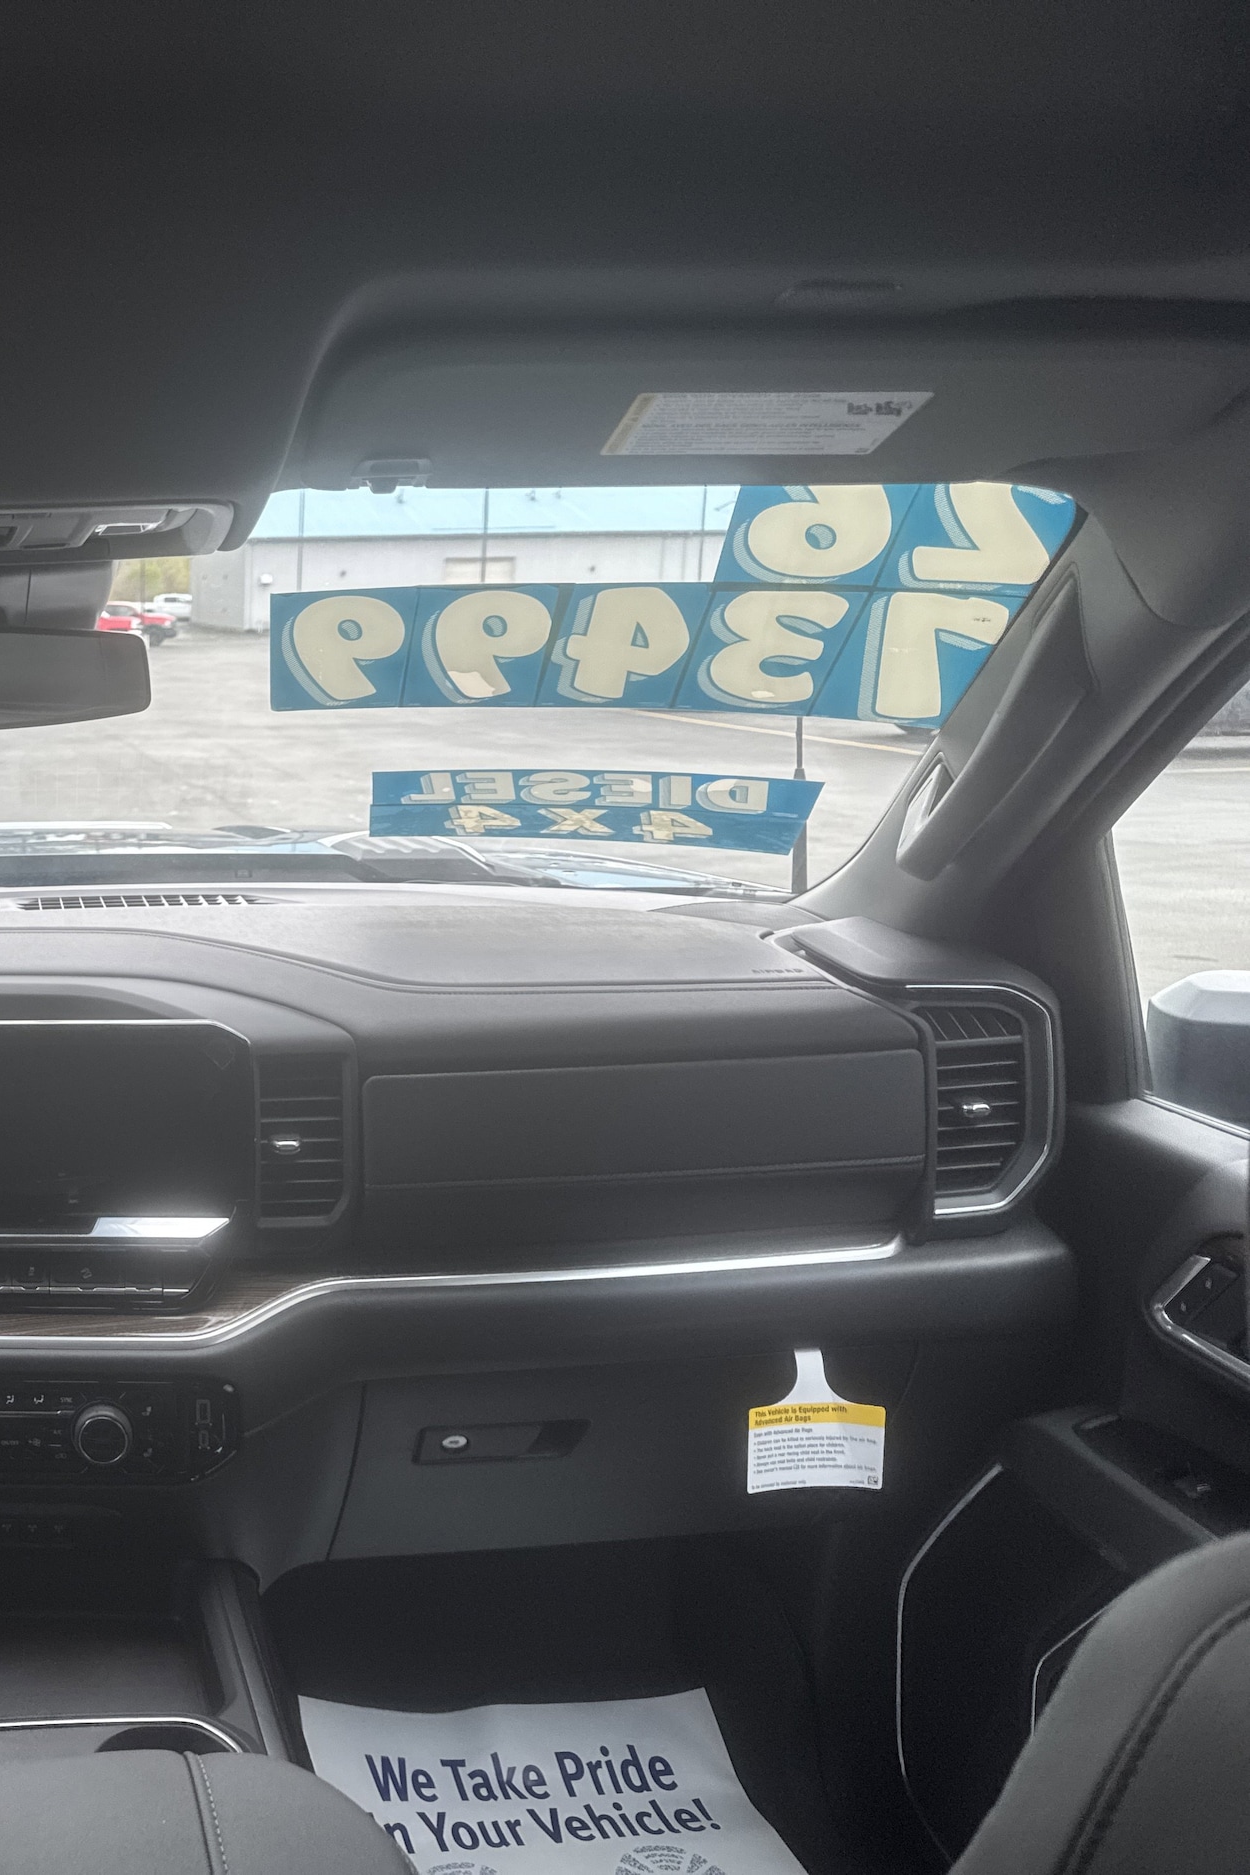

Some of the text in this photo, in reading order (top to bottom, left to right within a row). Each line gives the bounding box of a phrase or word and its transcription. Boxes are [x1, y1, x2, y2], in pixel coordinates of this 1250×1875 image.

[754, 1416, 783, 1426] Advanced
[768, 1408, 790, 1417] Vehicle
[798, 1406, 830, 1415] Equipped
[831, 1405, 848, 1413] with
[365, 1744, 678, 1802] We Take Pride
[367, 1798, 722, 1854] n Your Vehicle!
